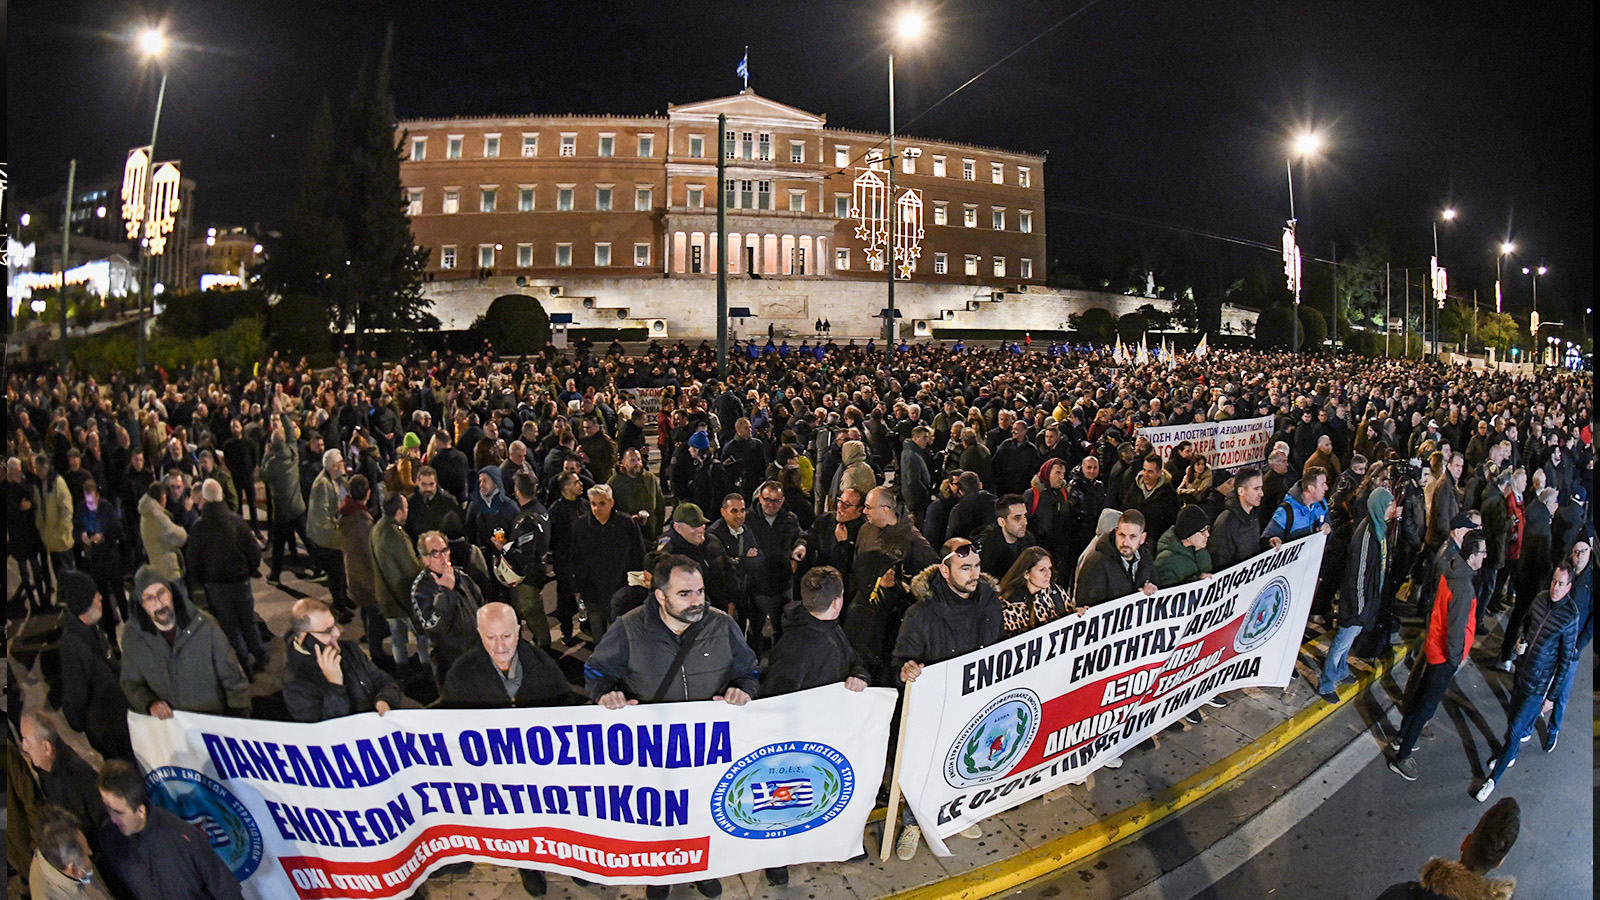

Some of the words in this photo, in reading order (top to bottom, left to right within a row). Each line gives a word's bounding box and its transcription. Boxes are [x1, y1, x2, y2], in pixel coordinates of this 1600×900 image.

[1220, 436, 1235, 449] από
[1238, 439, 1246, 447] το
[961, 643, 1044, 696] ΕΝΩΣΗ
[1046, 588, 1203, 661] ΣΤΡΑΤΙΩΤΙΚΩΝ
[1201, 542, 1306, 608] ΠΕΡΙΦΕΡΕΙΑΚΗΣ
[1069, 626, 1180, 684] ΕΝΟΤΗΤΑΣ
[1152, 646, 1226, 698] ΣΕΒΑΣΜΟΣ
[201, 731, 452, 789] ΠΑΝΕΛΛΑΔΙΚΗ
[459, 721, 733, 769] ΟΜΟΣΠΟΝΔΙΑ
[726, 743, 796, 780] ΟΜΟΣΠΟΝΔΙΑ
[802, 743, 844, 765] ΕΝΩΣΕΩΝ
[937, 794, 967, 826] ΣΕ
[1161, 683, 1196, 718] ΤΗΝ
[1194, 657, 1261, 702] ΠΑΤΡΙΔΑ
[768, 766, 804, 774] Π.Ο.Ε.Σ.
[821, 767, 853, 822] ΣΤΡΑΤΙΩΤΙΚΩΝ
[265, 792, 415, 848] ΕΝΩΣΕΩΝ
[412, 781, 689, 828] ΣΤΡΑΤΙΩΤΙΚΩΝ
[713, 782, 736, 833] ΠΑΝΕΛΛΑΔΙΚΗ
[765, 830, 787, 838] 2013
[292, 868, 331, 891] ΟΧΙ
[331, 873, 383, 892] στην
[382, 834, 481, 887] απαξίωση
[482, 836, 529, 854] των
[535, 836, 705, 869] Στρατιωτικών
